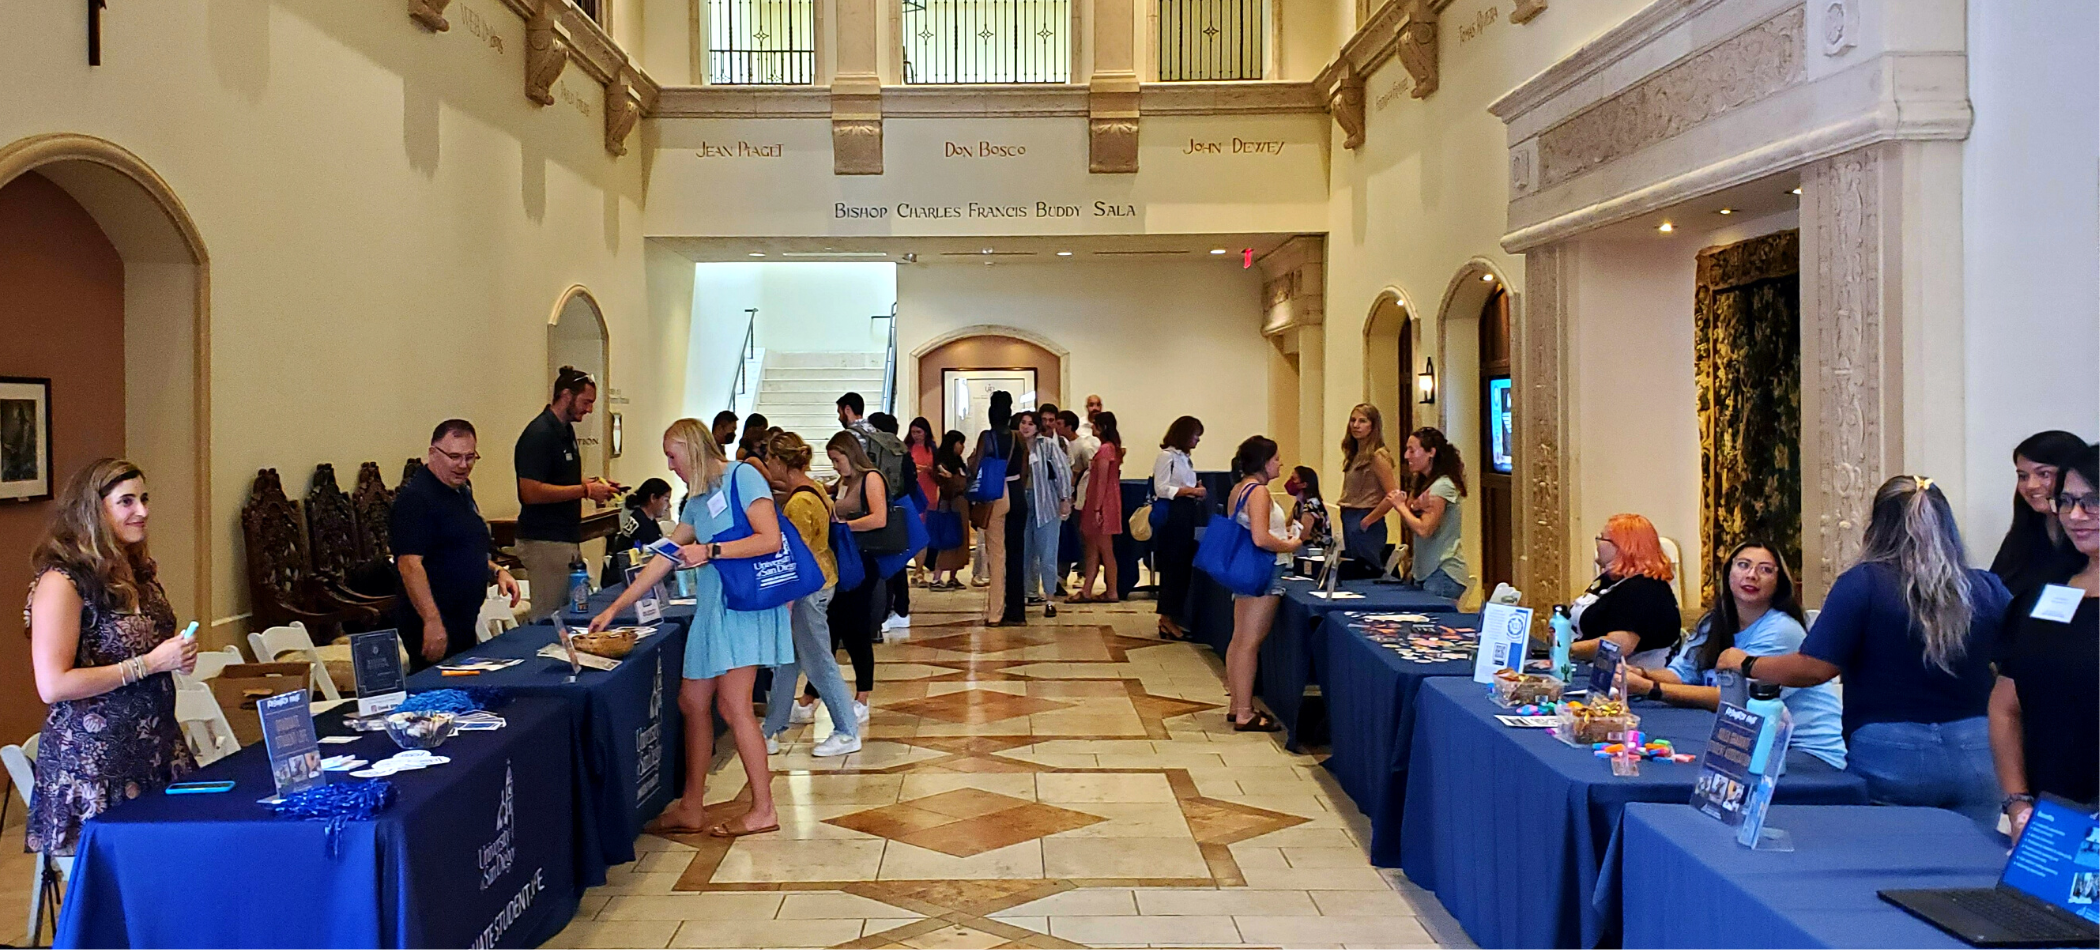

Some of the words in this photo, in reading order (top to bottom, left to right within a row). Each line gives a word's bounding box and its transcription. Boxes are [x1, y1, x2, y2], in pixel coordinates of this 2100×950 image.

[695, 141, 733, 158] JEAN
[737, 141, 785, 158] PIAGET
[944, 141, 973, 158] DON
[979, 141, 1027, 158] BOSCO
[1182, 137, 1222, 155] JOHN
[1232, 137, 1286, 155] DEWEY
[834, 202, 888, 219] BISHOP
[896, 202, 962, 219] CHARLES
[968, 201, 1027, 218] FRANCIS
[1035, 201, 1082, 218] BUDDY
[1093, 200, 1136, 217] SALA
[494, 882, 531, 943] STUDENT
